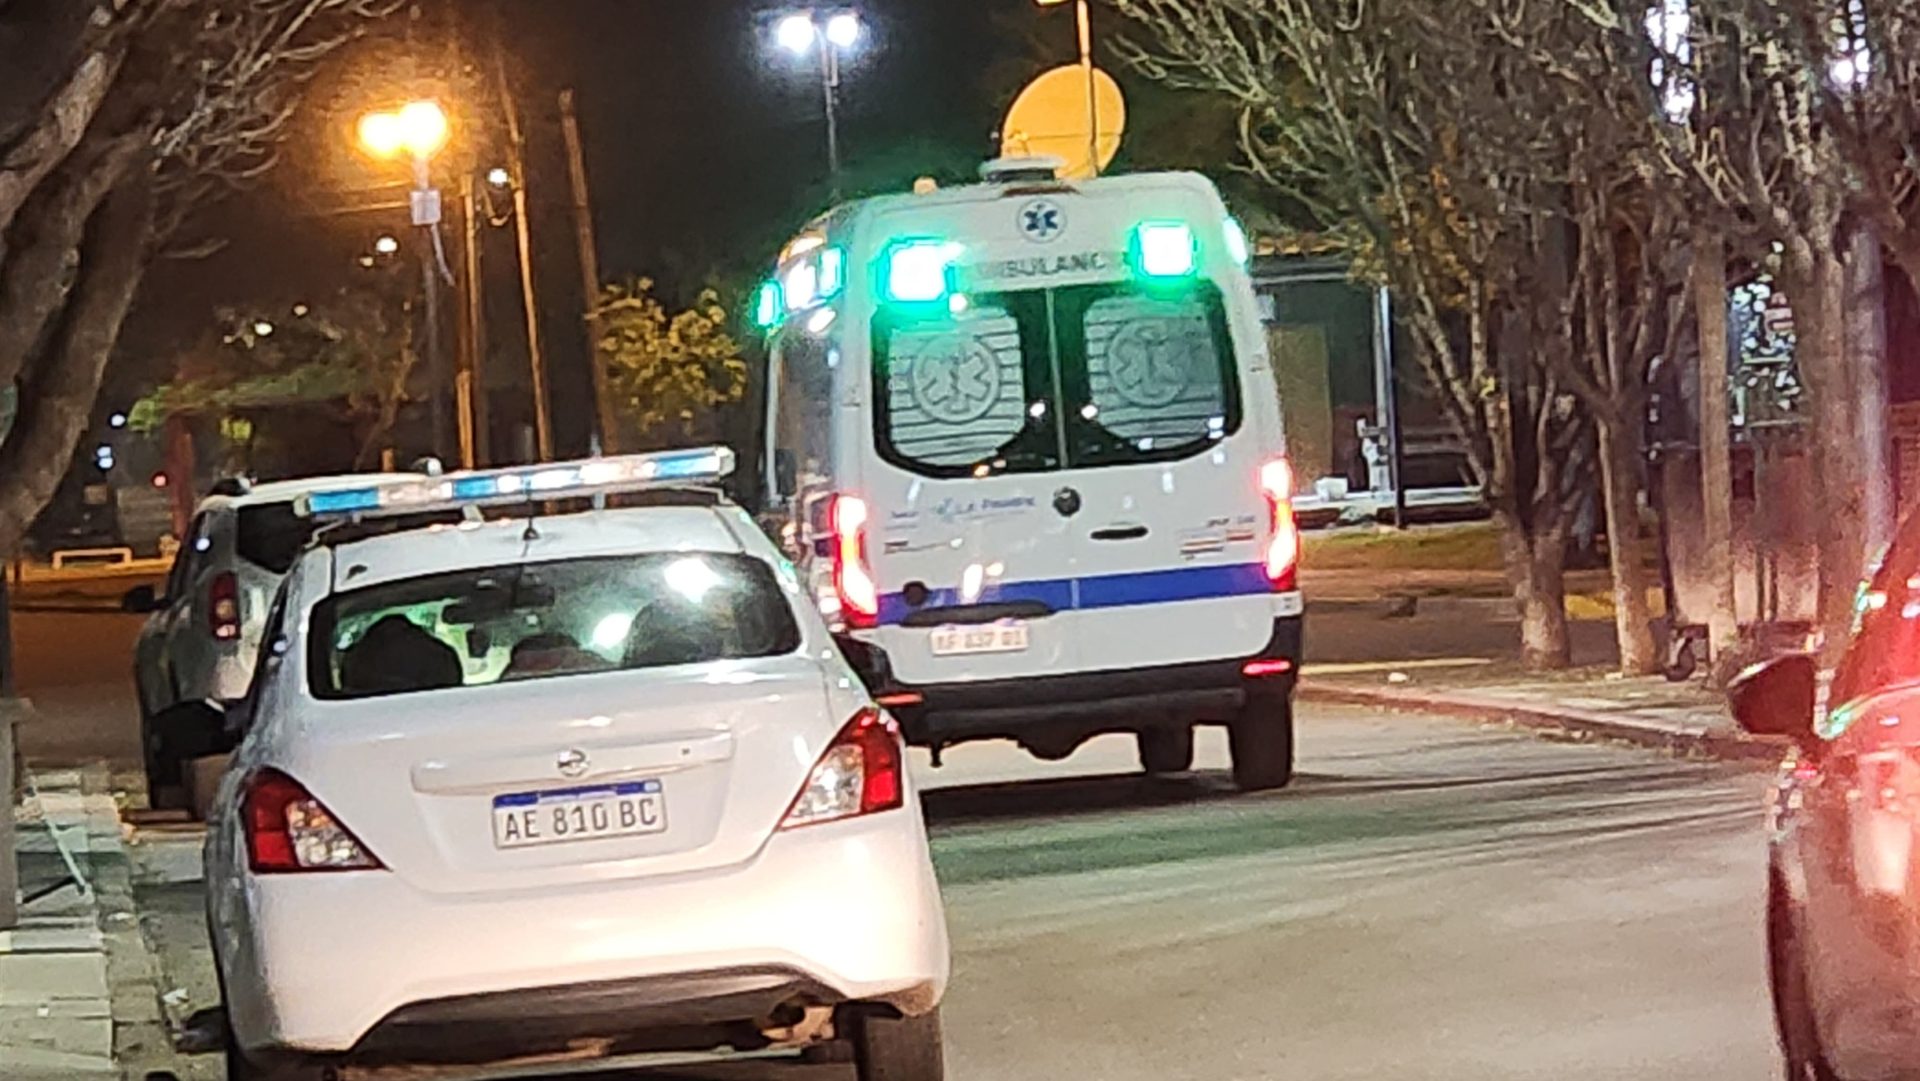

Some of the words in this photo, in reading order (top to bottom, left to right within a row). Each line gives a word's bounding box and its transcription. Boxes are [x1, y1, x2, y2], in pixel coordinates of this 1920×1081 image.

[978, 252, 1107, 279] BULANC
[504, 809, 540, 841] AE
[552, 803, 610, 837] 810
[620, 797, 659, 828] BC
